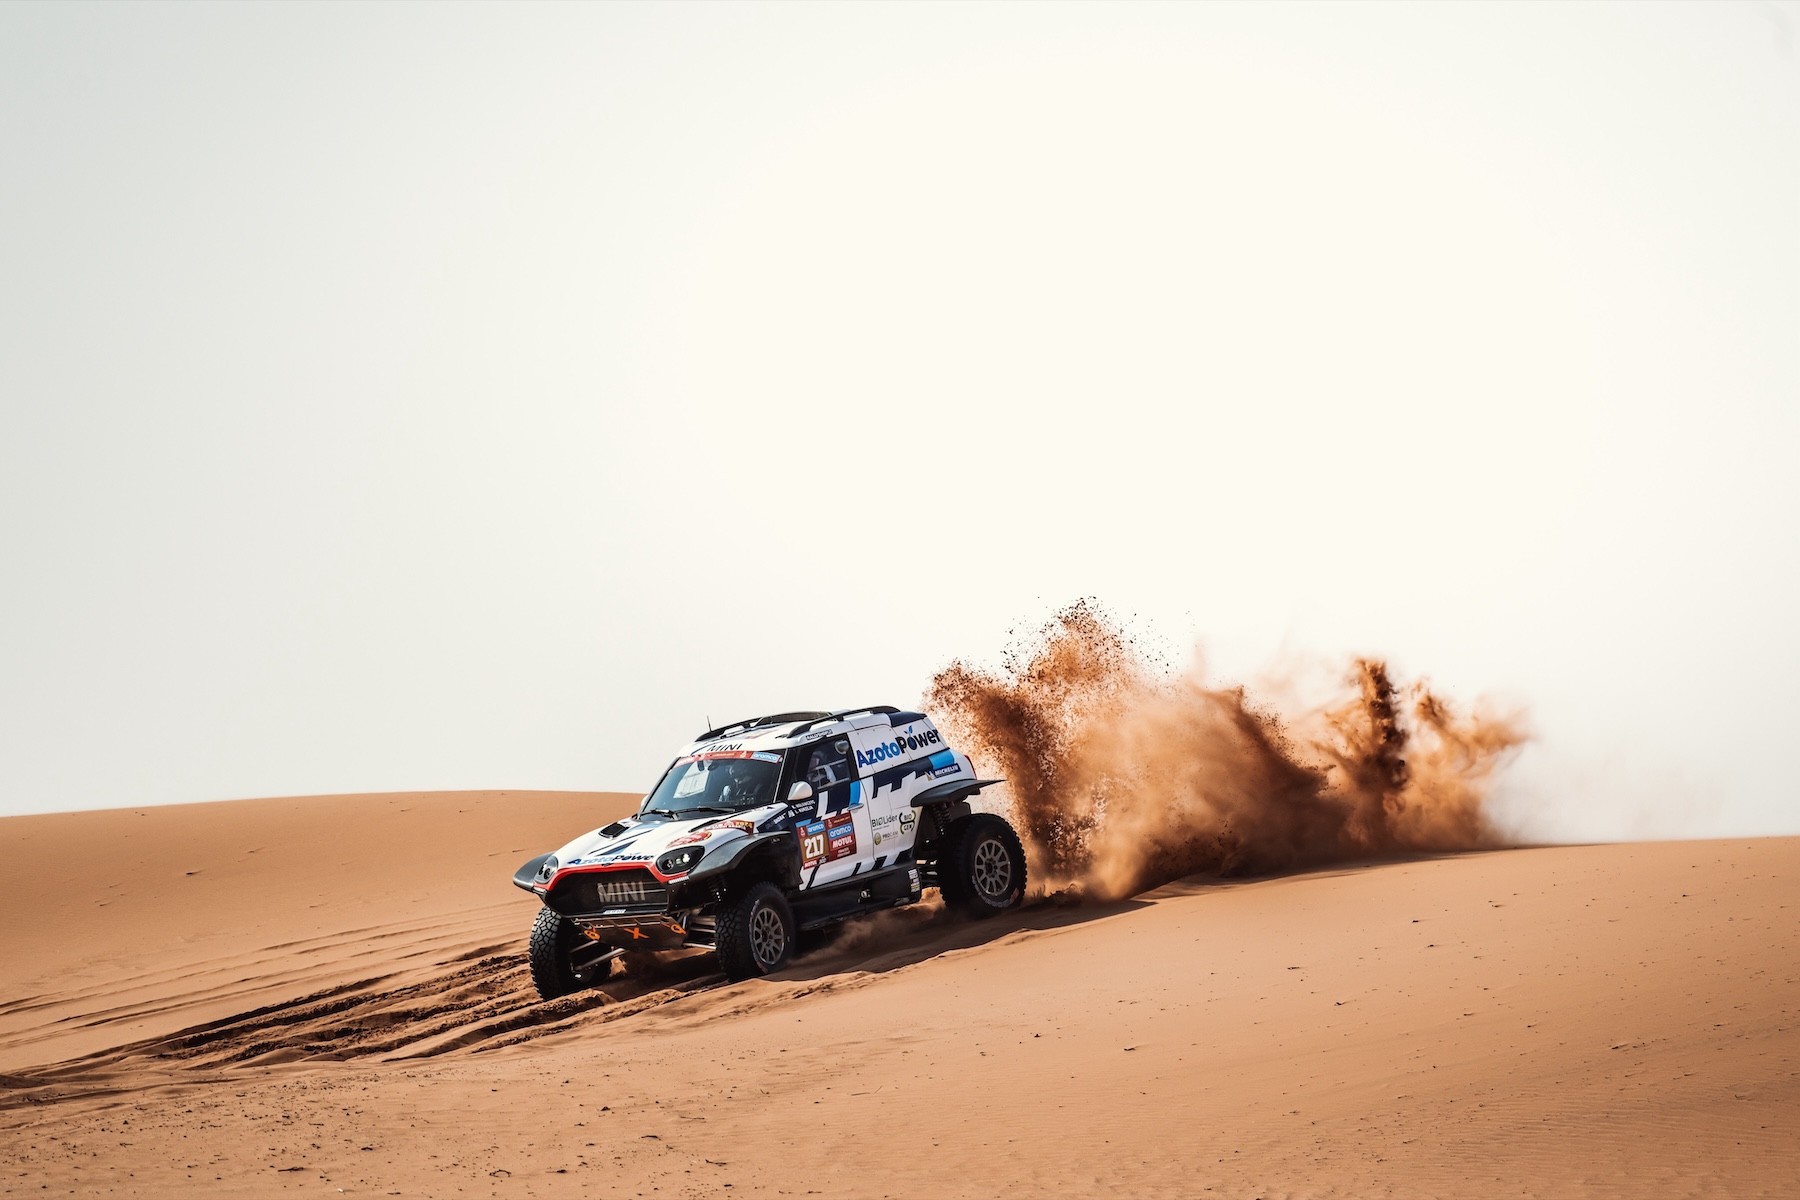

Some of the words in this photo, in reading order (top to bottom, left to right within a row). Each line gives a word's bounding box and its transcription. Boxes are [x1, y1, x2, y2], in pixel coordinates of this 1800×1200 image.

[707, 743, 743, 752] MINI
[856, 729, 941, 768] AzotoPower
[754, 752, 780, 762] aramco
[934, 764, 959, 776] MICHELIN
[807, 822, 825, 833] aramco
[829, 825, 852, 838] aramco
[804, 834, 824, 859] 217
[832, 836, 853, 849] MOTUL
[597, 881, 646, 903] MINI
